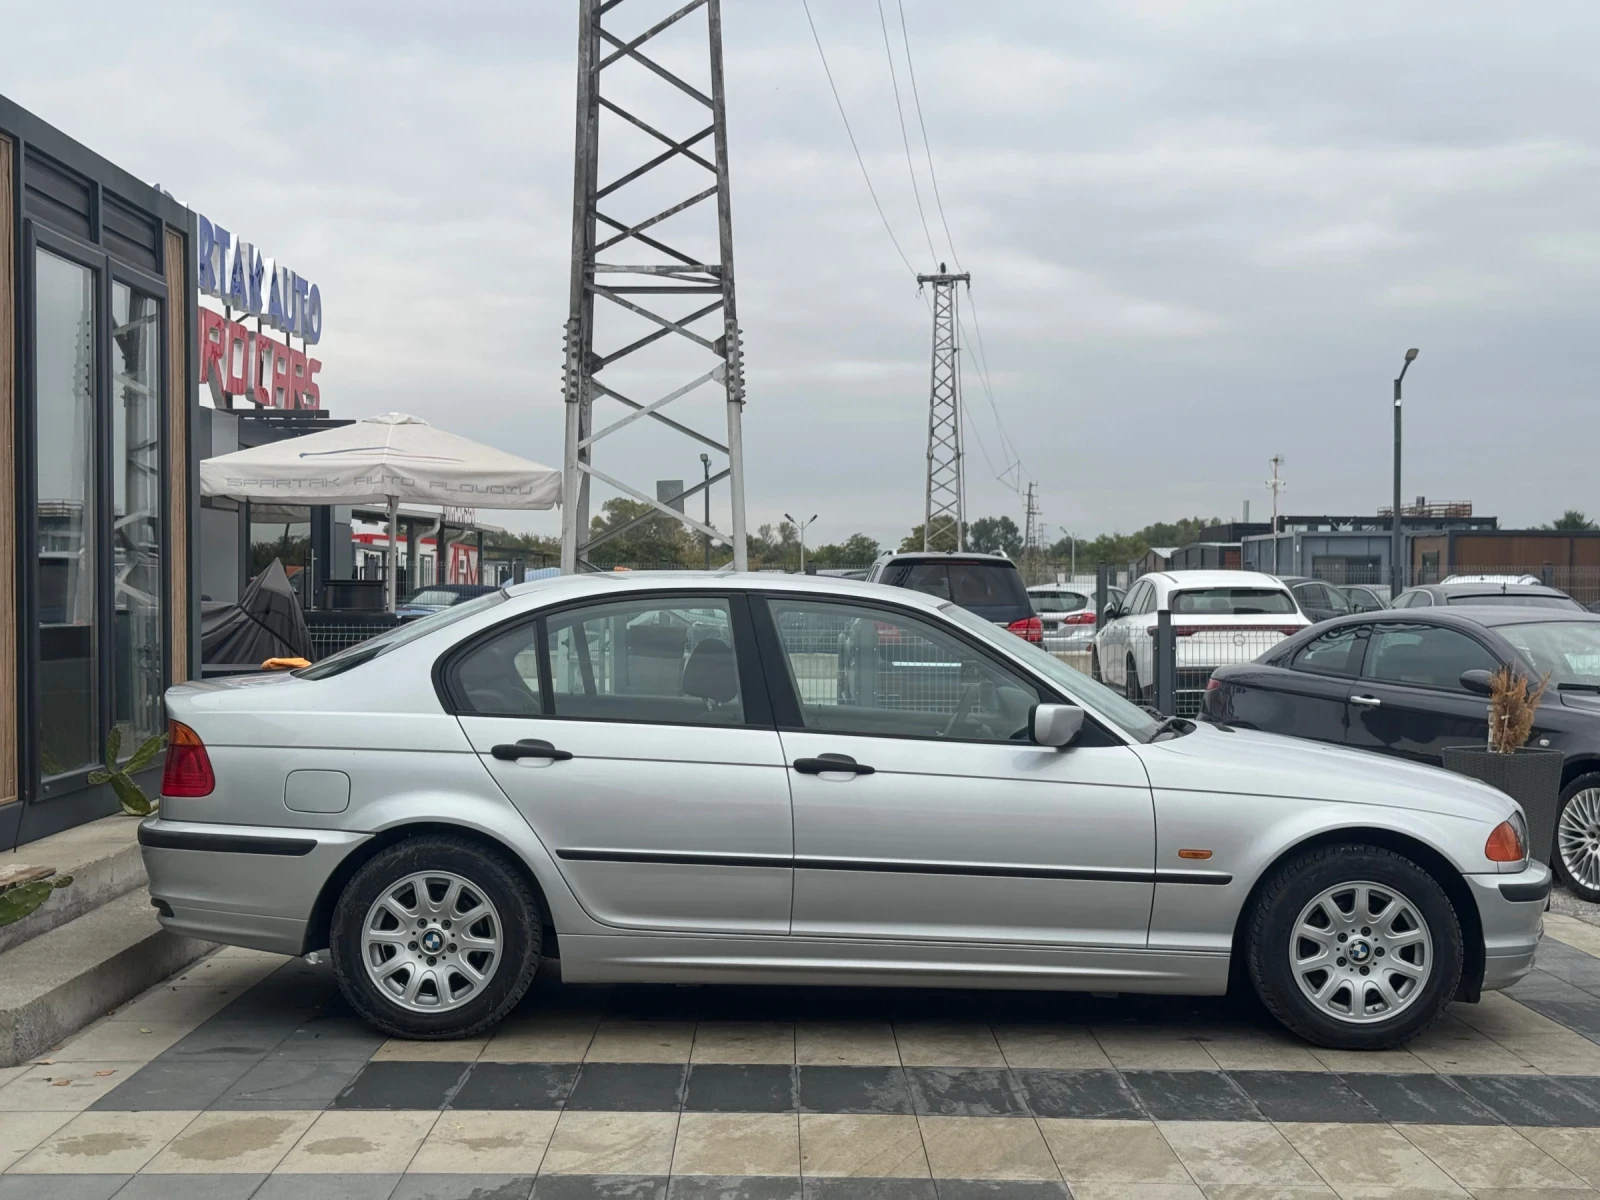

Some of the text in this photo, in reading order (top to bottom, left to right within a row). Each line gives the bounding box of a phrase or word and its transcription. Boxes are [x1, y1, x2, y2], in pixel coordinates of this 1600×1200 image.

[198, 213, 321, 345] RTAK AUTO
[198, 306, 322, 409] ROCARS
[226, 477, 340, 488] SPARTAK
[354, 475, 415, 487] AUTO
